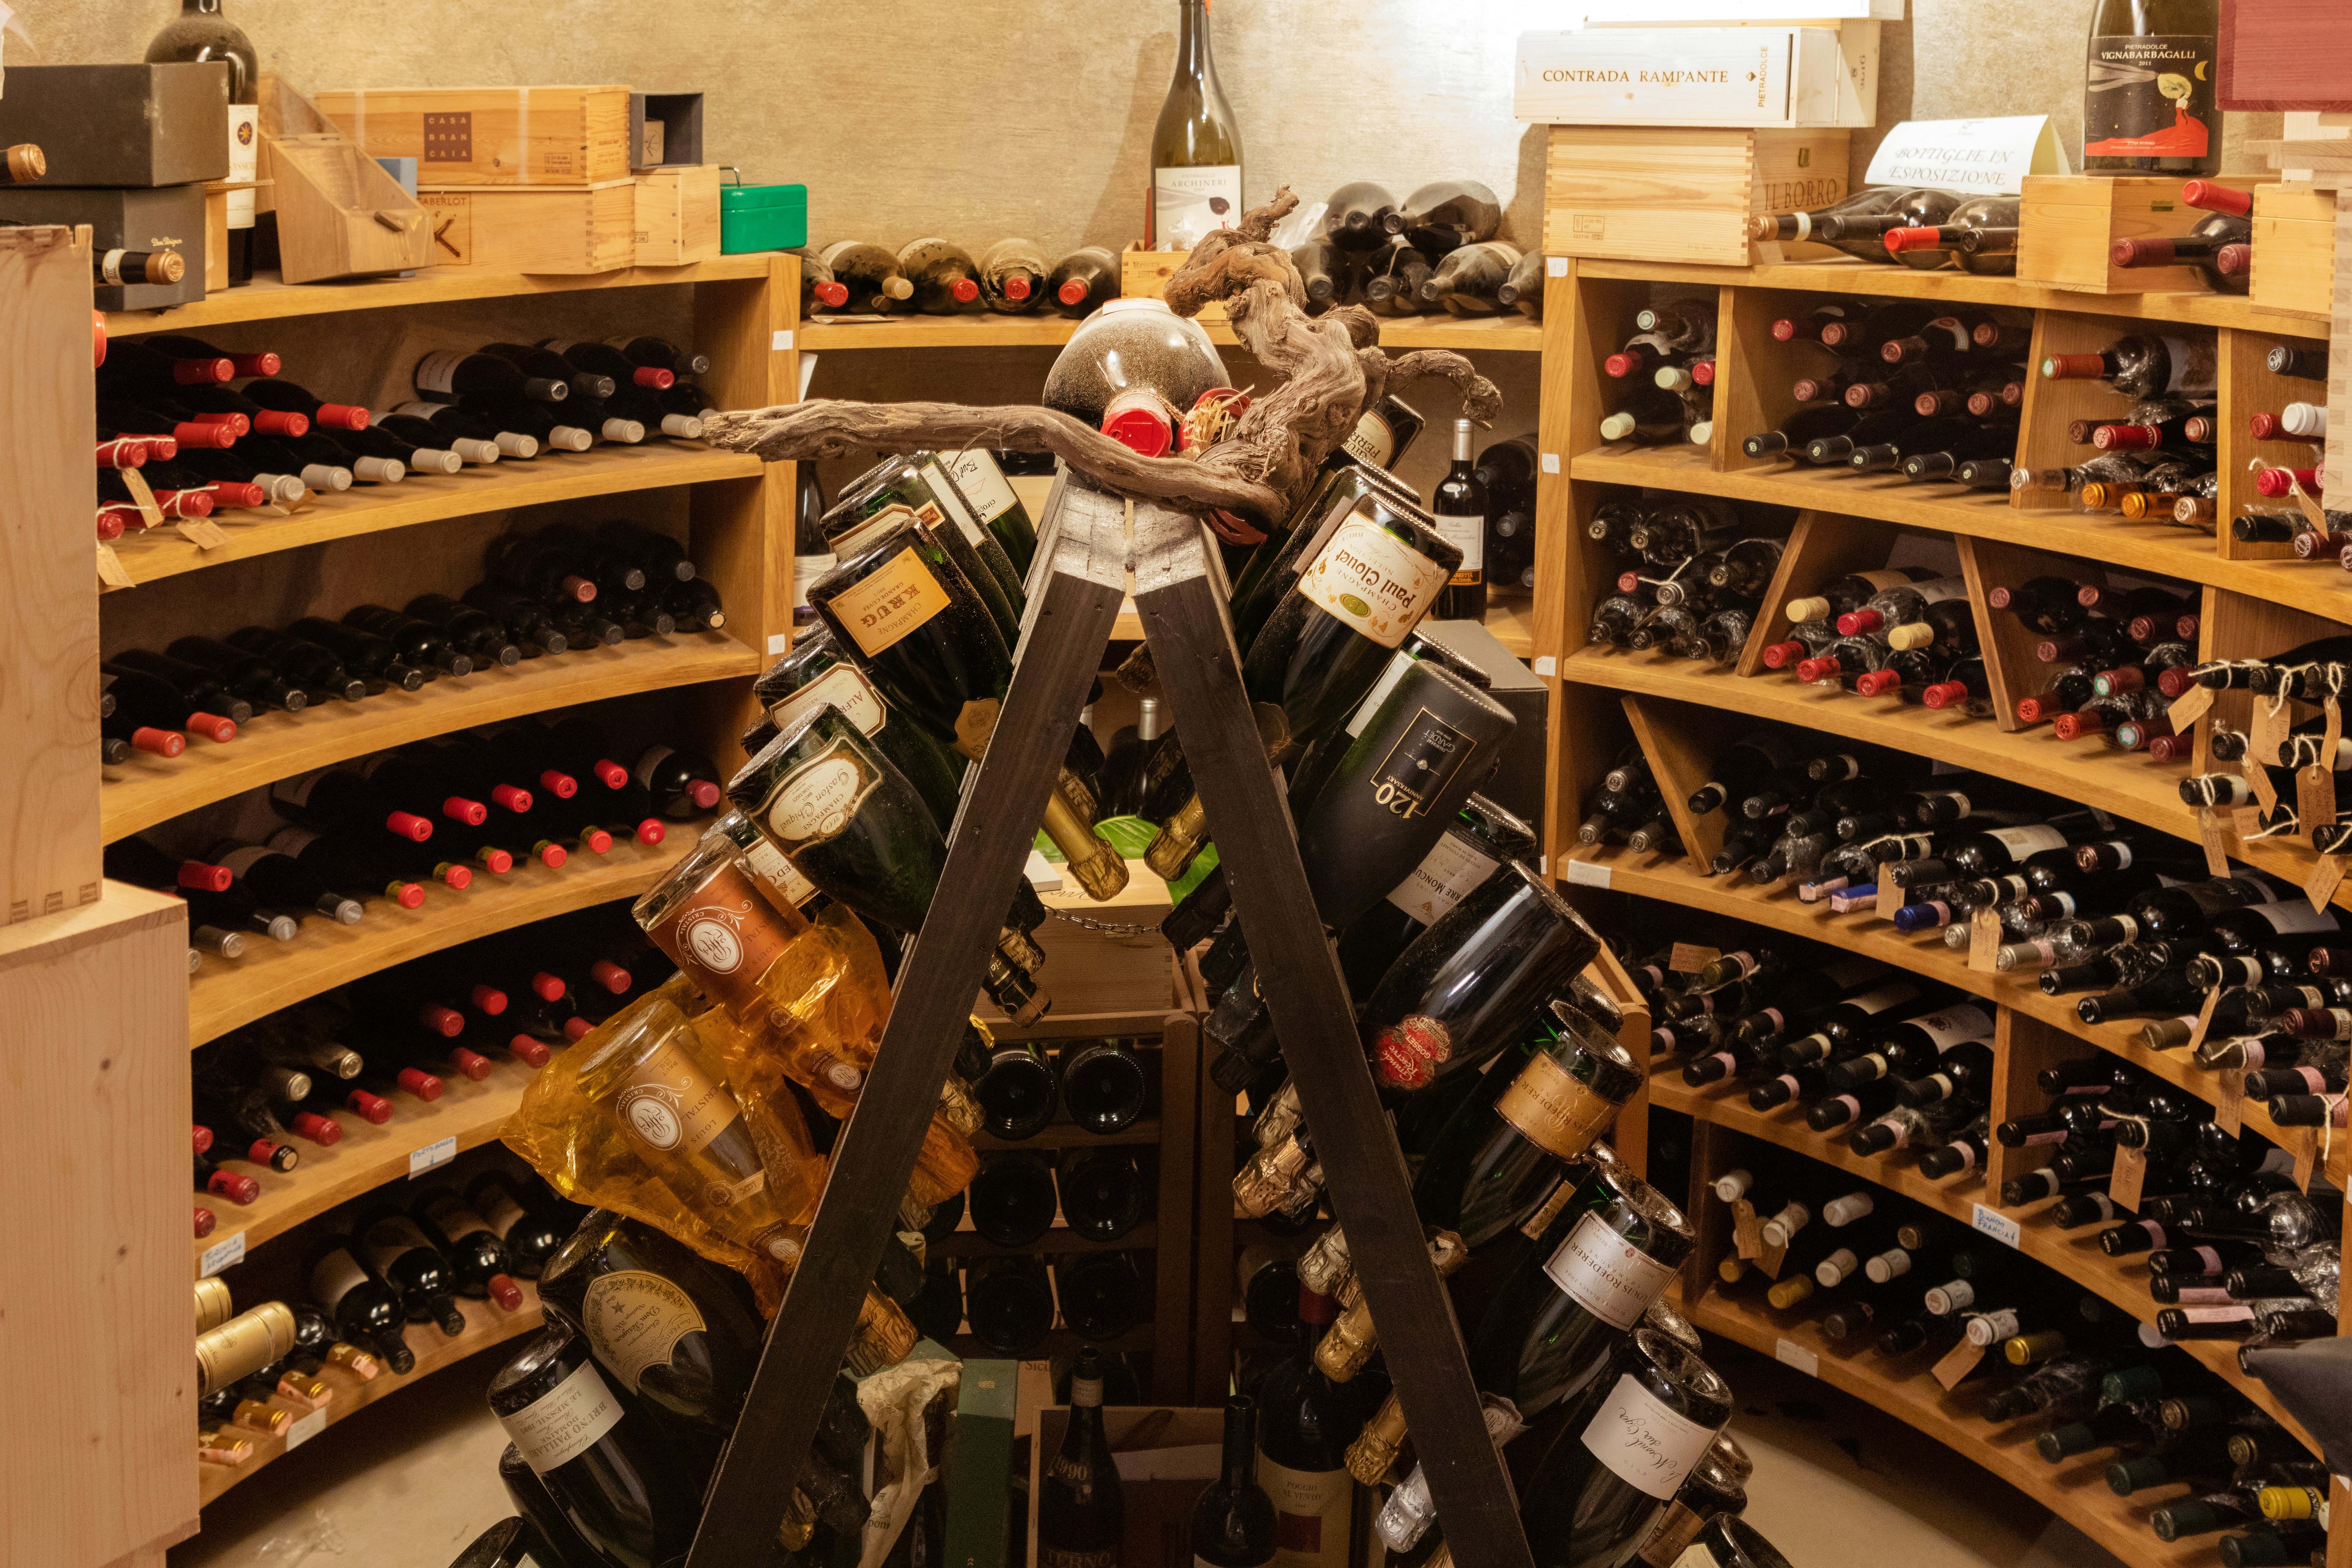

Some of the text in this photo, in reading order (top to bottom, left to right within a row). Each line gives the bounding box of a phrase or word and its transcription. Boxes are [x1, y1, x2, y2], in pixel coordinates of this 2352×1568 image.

[2101, 51, 2196, 60] VIGNABARBAGALLI
[1543, 70, 1729, 83] CONTRADA RAMPANTE
[1758, 46, 1767, 107] PIETRADOLCE
[1896, 147, 2015, 164] BOTTIGLIE IN
[1889, 166, 2006, 186] ESPOSIZIONE
[1765, 179, 1837, 210] IL BORRO
[1361, 415, 1380, 430] TRENTODO
[1343, 532, 1362, 542] BRUT
[1348, 543, 1394, 577] SELECTION
[879, 582, 904, 600] GRANDE
[1332, 547, 1417, 611] Paul Clouet
[1335, 567, 1397, 612] CHAMPAGNE
[872, 587, 886, 597] BRUT
[859, 583, 921, 630] KRUG
[862, 597, 881, 612] CUVÉE
[877, 602, 922, 635] CHAMPAGNE
[801, 697, 819, 710] BRUT
[1423, 728, 1456, 752] GARDET
[1425, 737, 1446, 753] CHAMPAGNE
[791, 783, 814, 803] 51530 DIZY
[801, 791, 813, 802] BRUT
[1386, 774, 1424, 801] ANNIVERSARY
[779, 768, 849, 832] Gaston Chiquet
[1372, 780, 1419, 821] 120
[801, 794, 844, 831] CHAMPAGNE
[822, 815, 840, 832] 2000
[1440, 842, 1459, 856] COULMET
[1443, 867, 1456, 877] BRUT
[680, 912, 704, 931] CRISTAL
[1421, 1019, 1446, 1045] CHAMPAGNE
[1405, 1034, 1431, 1059] GOSSET
[661, 1061, 678, 1076] BRUT
[1380, 1049, 1412, 1082] Grande
[1387, 1045, 1419, 1077] Réserve
[619, 1089, 643, 1107] CRISTAL
[683, 1086, 718, 1121] CRISTAL
[1521, 1080, 1572, 1125] ROEDERER
[689, 1119, 716, 1144] LOUIS
[1592, 1231, 1608, 1247] REIMS
[1977, 1219, 2010, 1239] FRANCIA
[1564, 1270, 1578, 1283] 2004
[1570, 1242, 1648, 1303] LOUIS ROEDERER
[1588, 1249, 1640, 1288] CHAMPAGNE
[1578, 1282, 1600, 1302] BLANCS
[624, 1303, 646, 1320] Vintage
[613, 1305, 660, 1345] Dom Pérignon
[626, 1319, 660, 1347] Champagne
[577, 1361, 590, 1374] BRUT
[569, 1390, 582, 1402] LE
[535, 1400, 570, 1427] MESNIL
[571, 1401, 608, 1435] BRUNO
[540, 1415, 579, 1443] DOMAINE
[1619, 1408, 1662, 1450] sur Oger
[553, 1433, 591, 1459] Champagne
[1625, 1436, 1676, 1466] Mesnil
[1287, 1481, 1317, 1491] POGGIO
